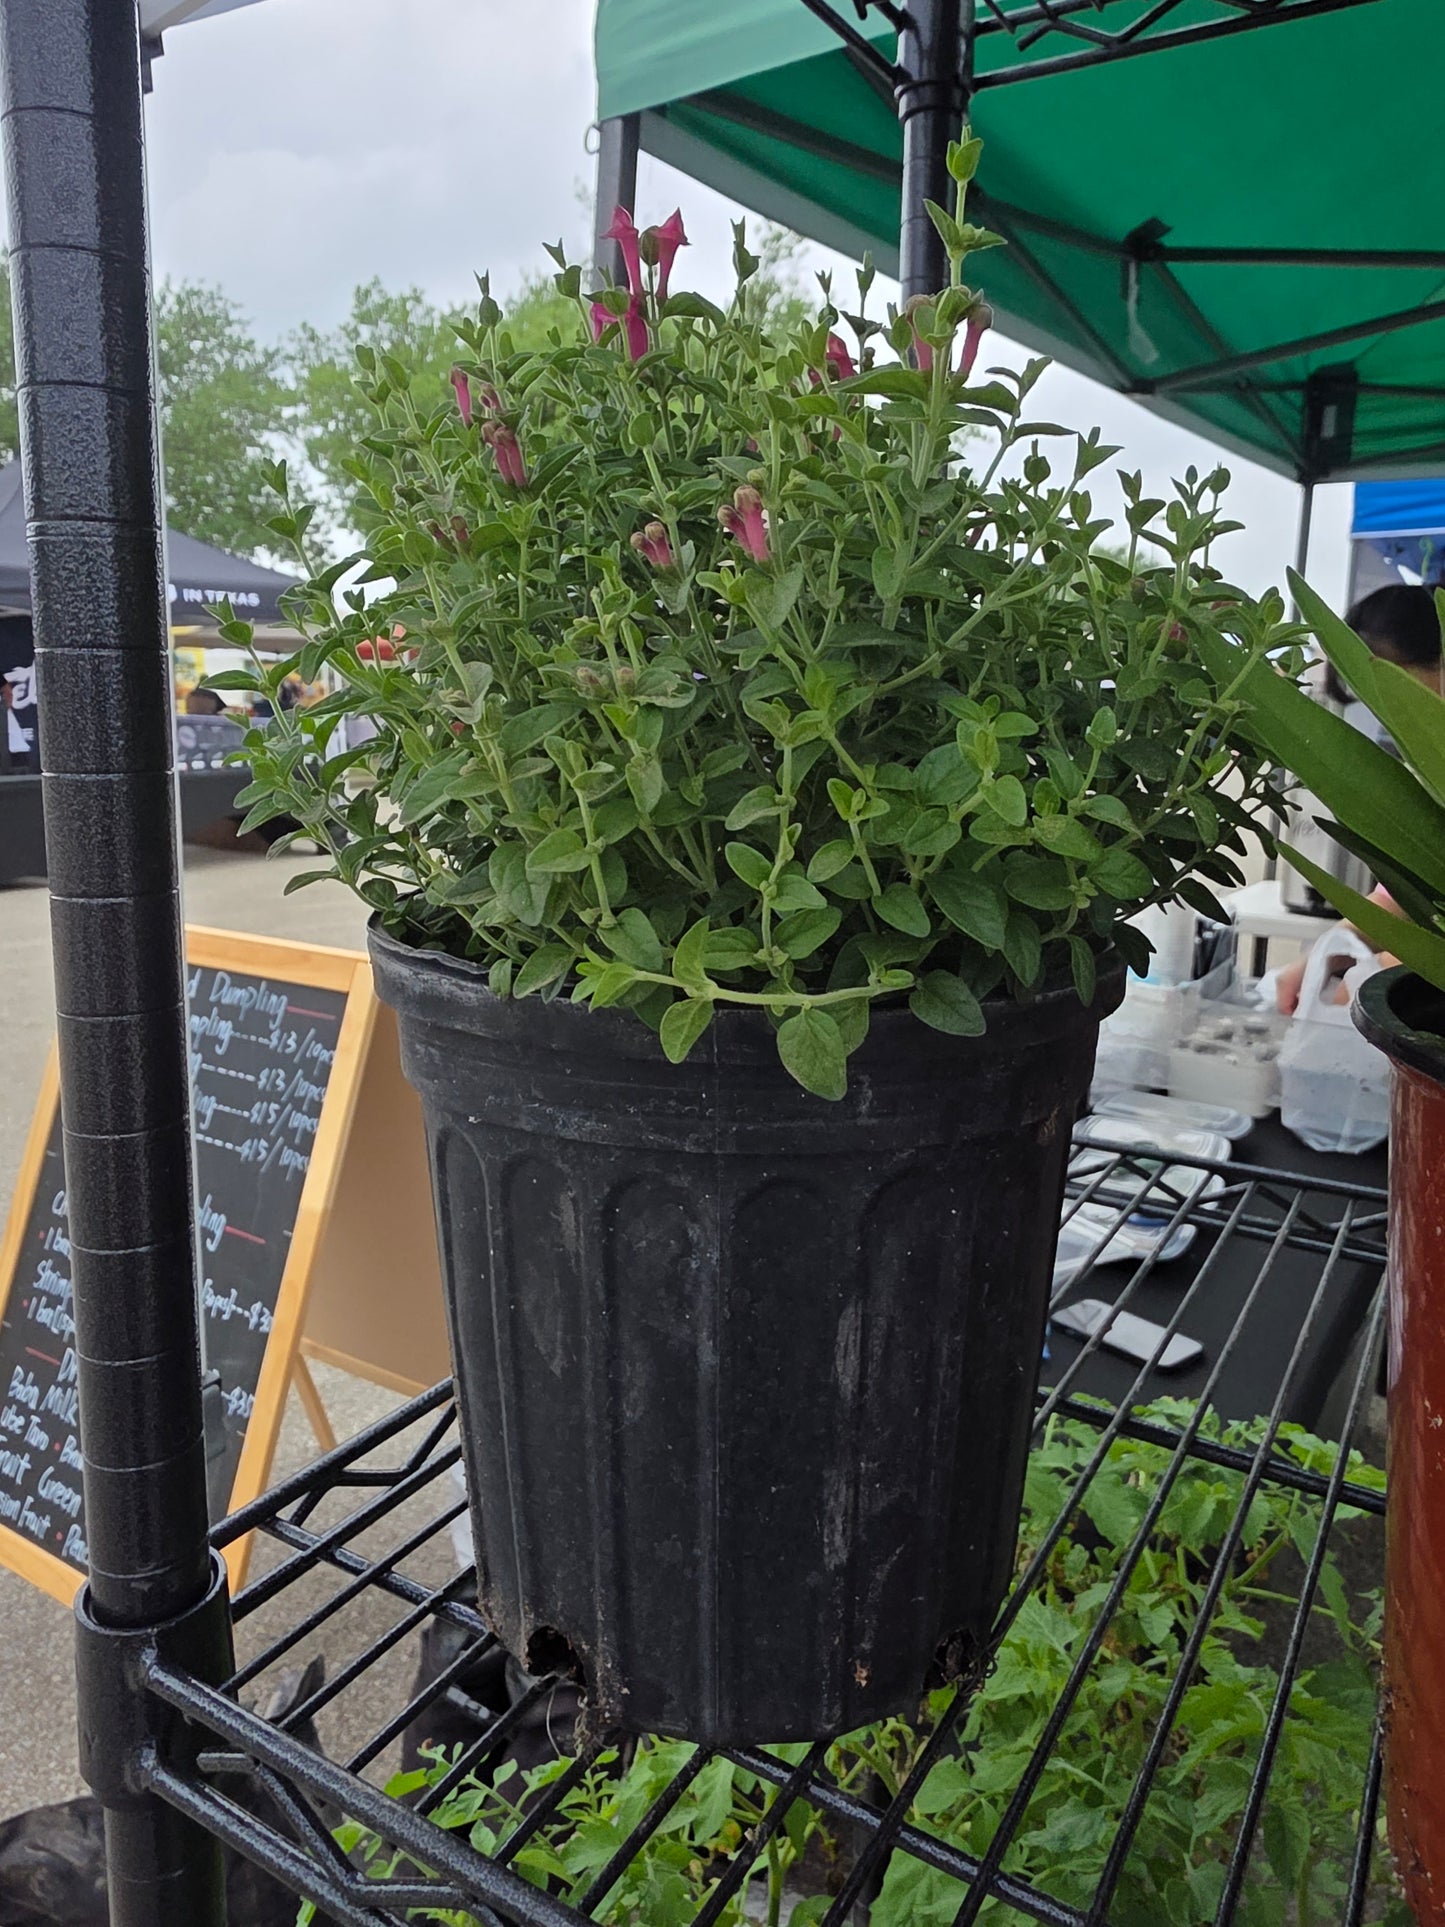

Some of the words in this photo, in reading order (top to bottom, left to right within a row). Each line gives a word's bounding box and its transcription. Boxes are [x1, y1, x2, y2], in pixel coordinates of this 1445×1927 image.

[183, 588, 203, 603] IN
[204, 589, 260, 607] TEXAS
[209, 971, 288, 1030] Dumpling
[39, 1384, 78, 1427] Milk
